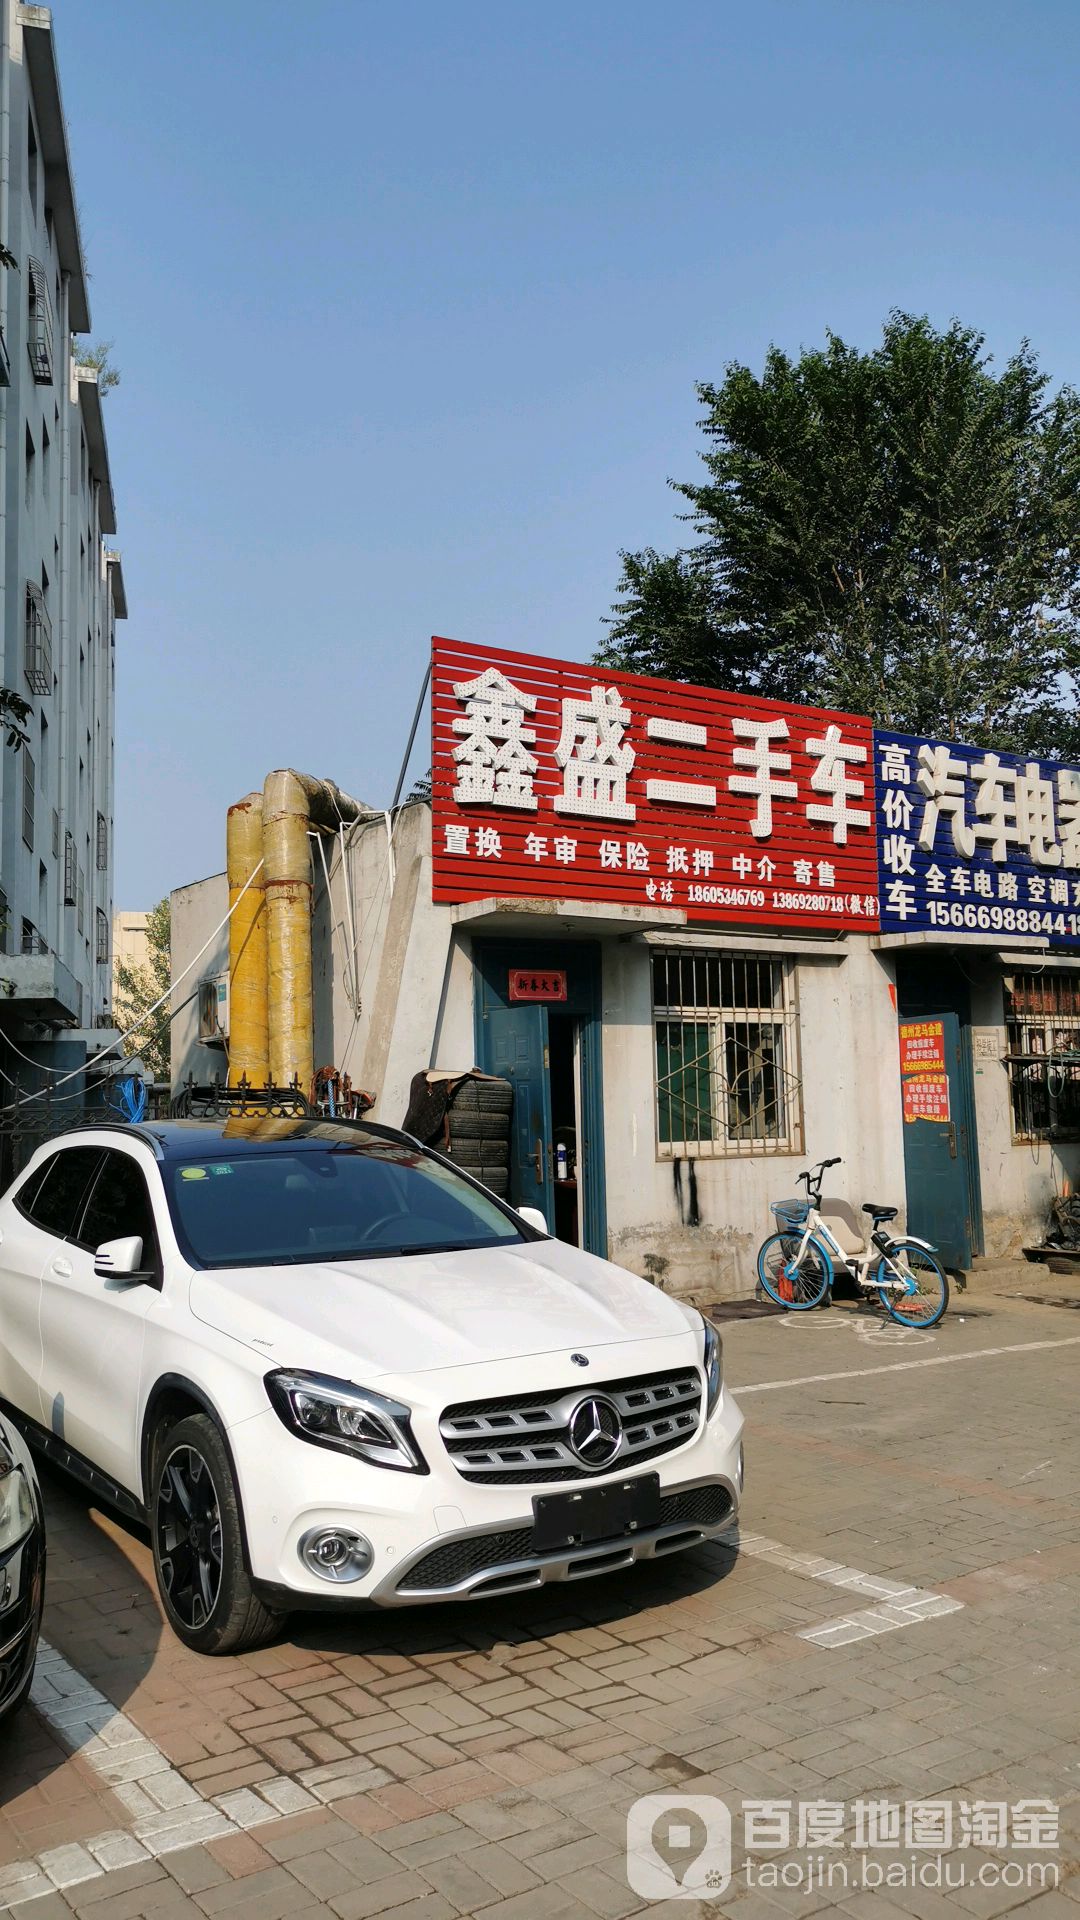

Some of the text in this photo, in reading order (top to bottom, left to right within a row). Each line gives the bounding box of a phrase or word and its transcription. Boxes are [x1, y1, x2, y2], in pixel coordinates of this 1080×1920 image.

[452, 667, 871, 845] 鑫盛二手车
[444, 824, 836, 888] 置换 年审 保险 抵押 中介 寄售
[879, 744, 917, 920] 高价收车
[645, 878, 674, 903] 电话
[688, 884, 765, 908] 18605346769
[925, 864, 1018, 901] 全车电路
[518, 978, 560, 992] 新春大吉
